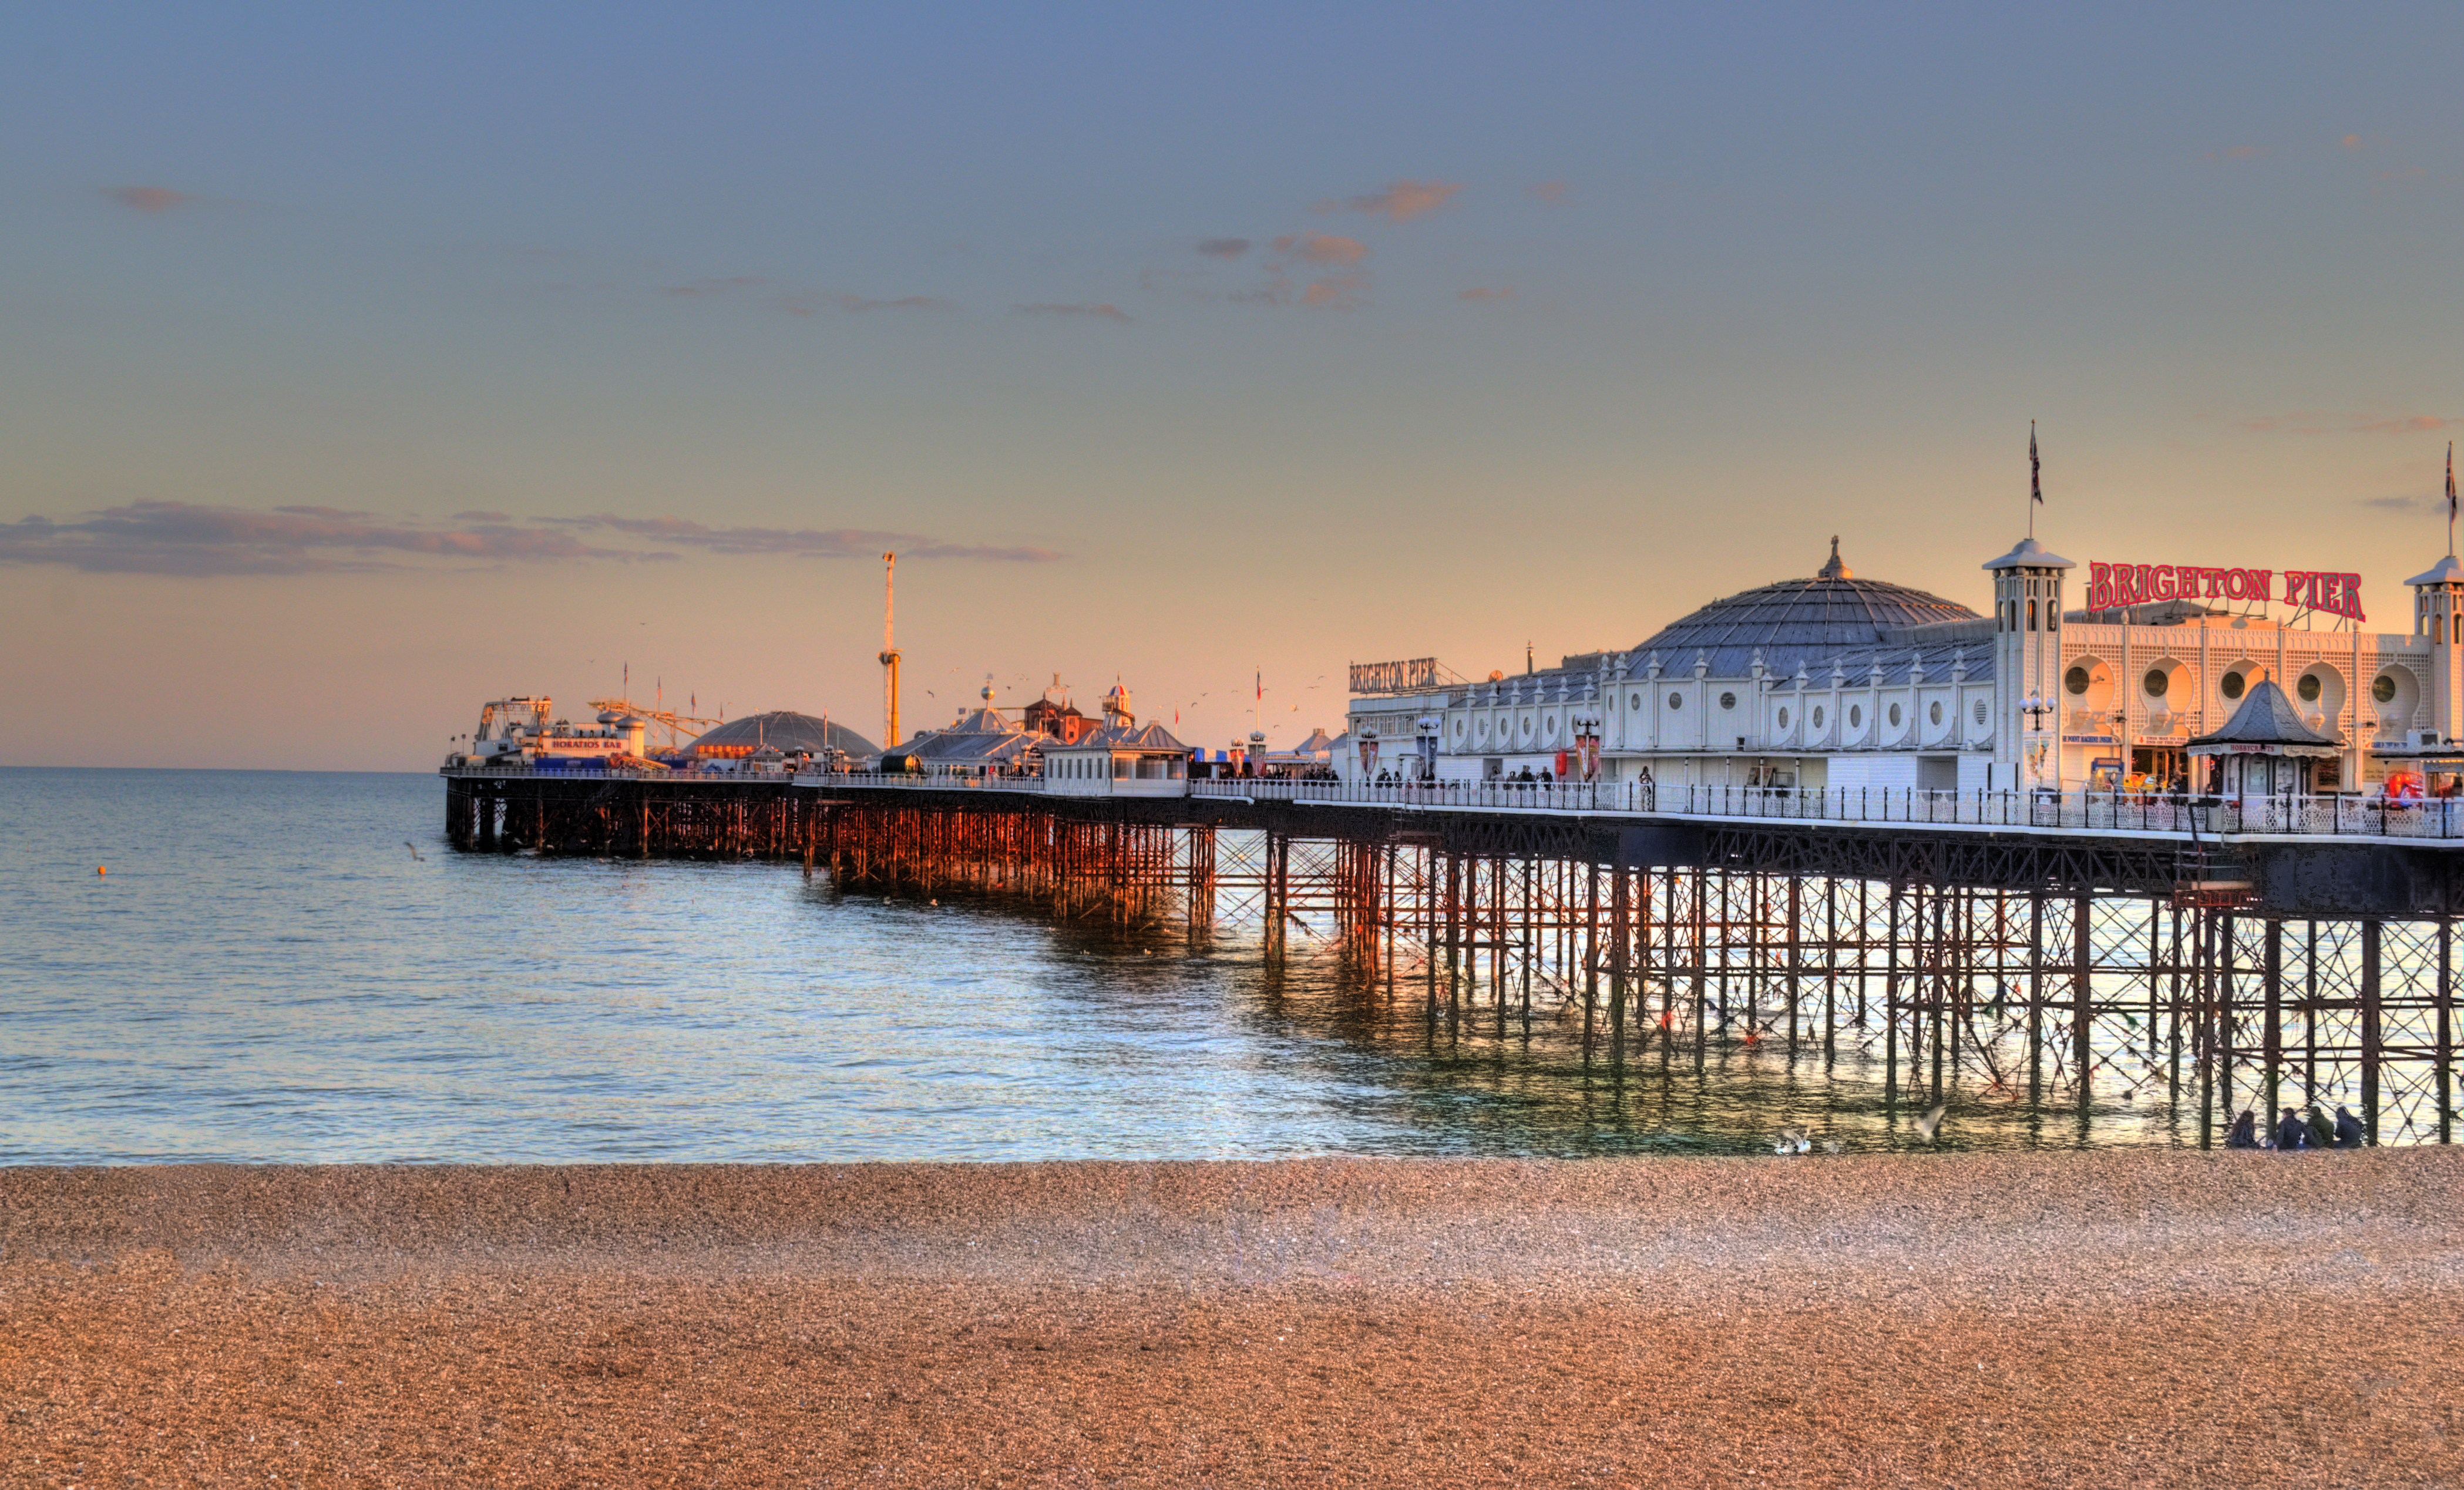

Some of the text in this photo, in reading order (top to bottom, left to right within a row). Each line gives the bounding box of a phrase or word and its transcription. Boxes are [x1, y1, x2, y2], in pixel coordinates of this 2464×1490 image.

[2090, 562, 2365, 623] BRIGHTON PIER
[1349, 657, 1435, 692] BRIGHTON PIER
